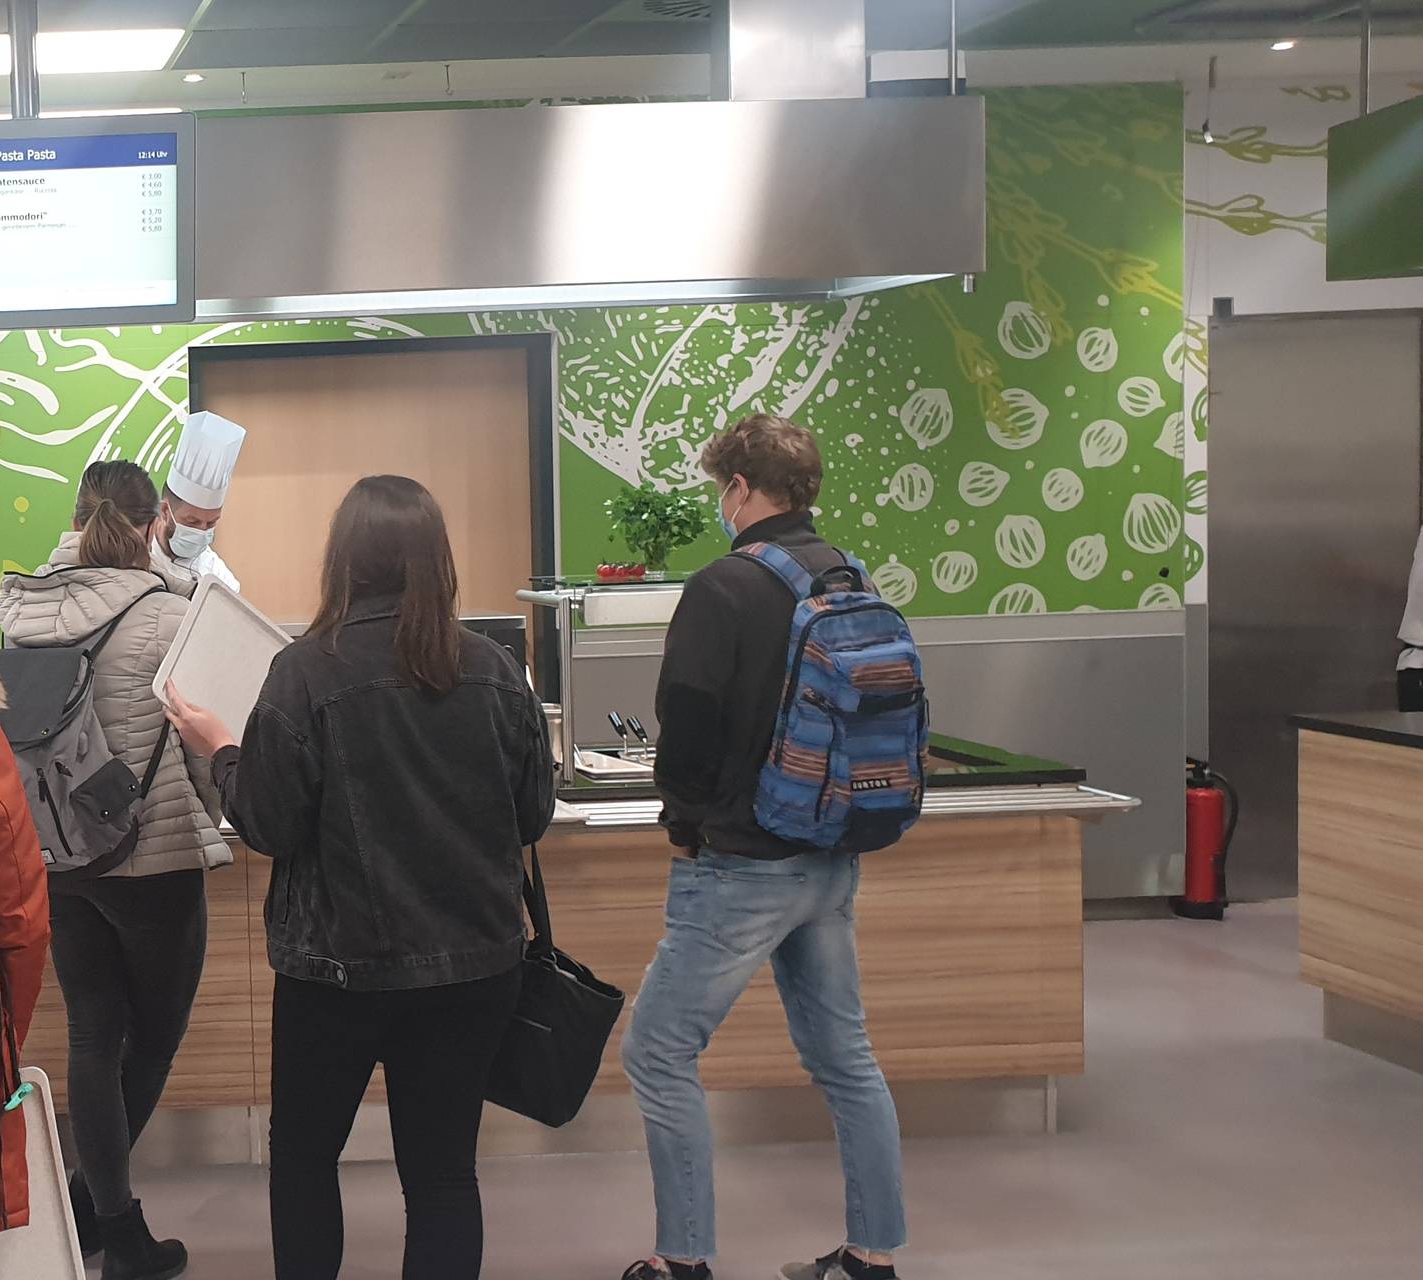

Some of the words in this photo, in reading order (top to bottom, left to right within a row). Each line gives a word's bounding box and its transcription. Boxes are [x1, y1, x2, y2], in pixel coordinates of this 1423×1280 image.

[27, 149, 57, 161] Pasta
[138, 151, 155, 159] 12:14
[156, 150, 168, 158] Uhr
